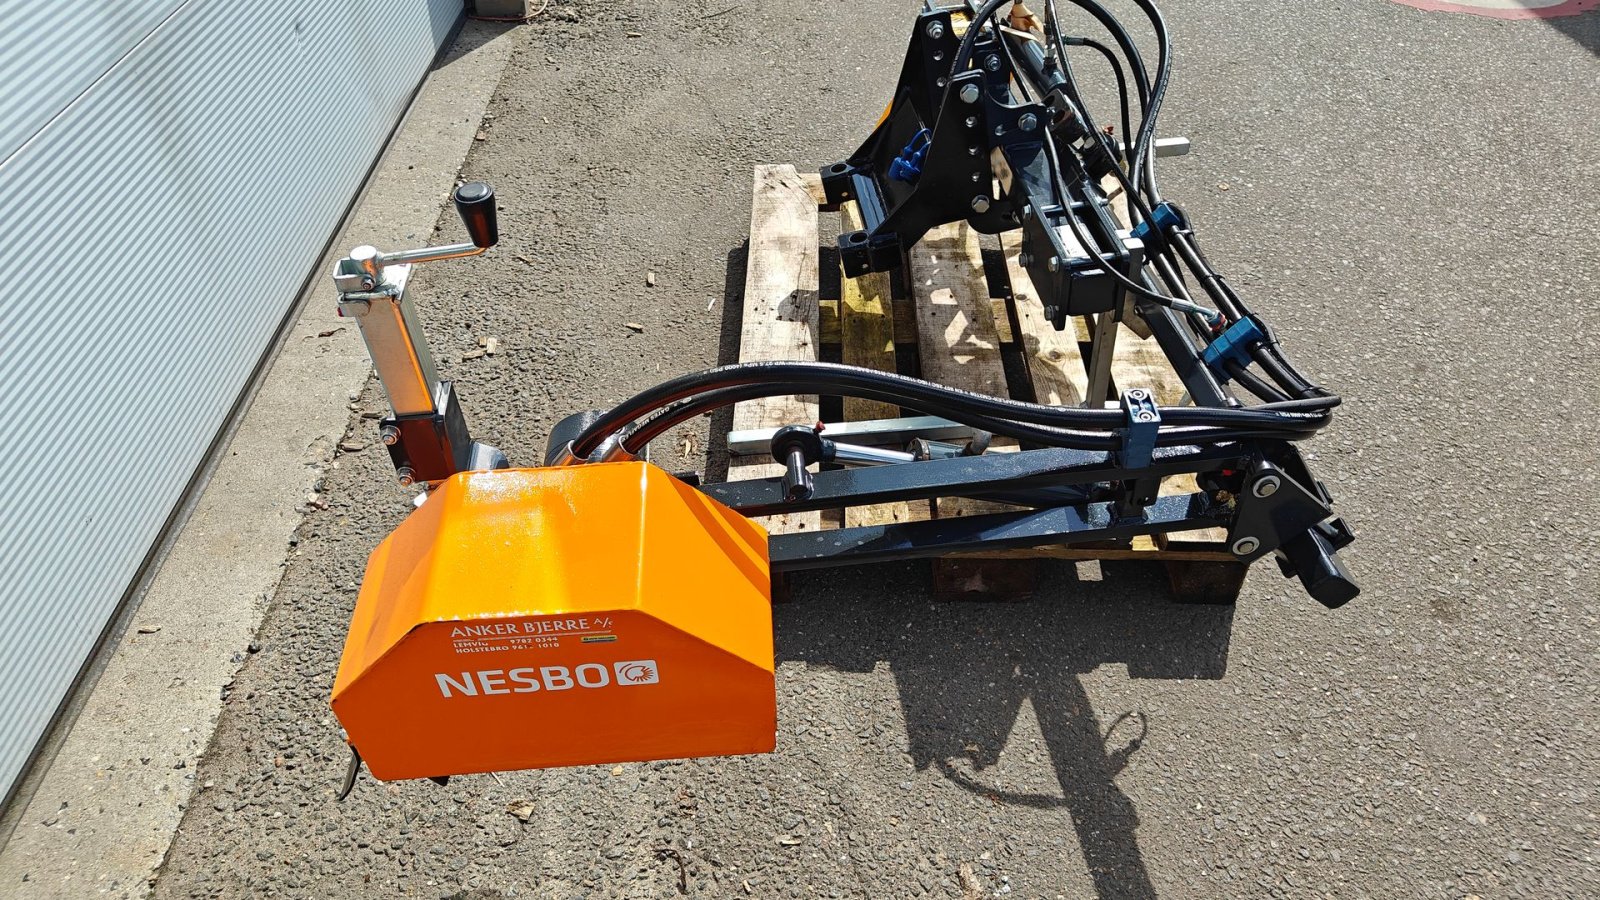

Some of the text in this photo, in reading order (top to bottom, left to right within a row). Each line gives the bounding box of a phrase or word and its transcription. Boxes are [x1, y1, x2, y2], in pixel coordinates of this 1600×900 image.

[451, 622, 520, 639] ANKER
[523, 617, 590, 635] BJERRE
[455, 645, 510, 654] HOLSTEBRO
[434, 663, 610, 699] NESBO
